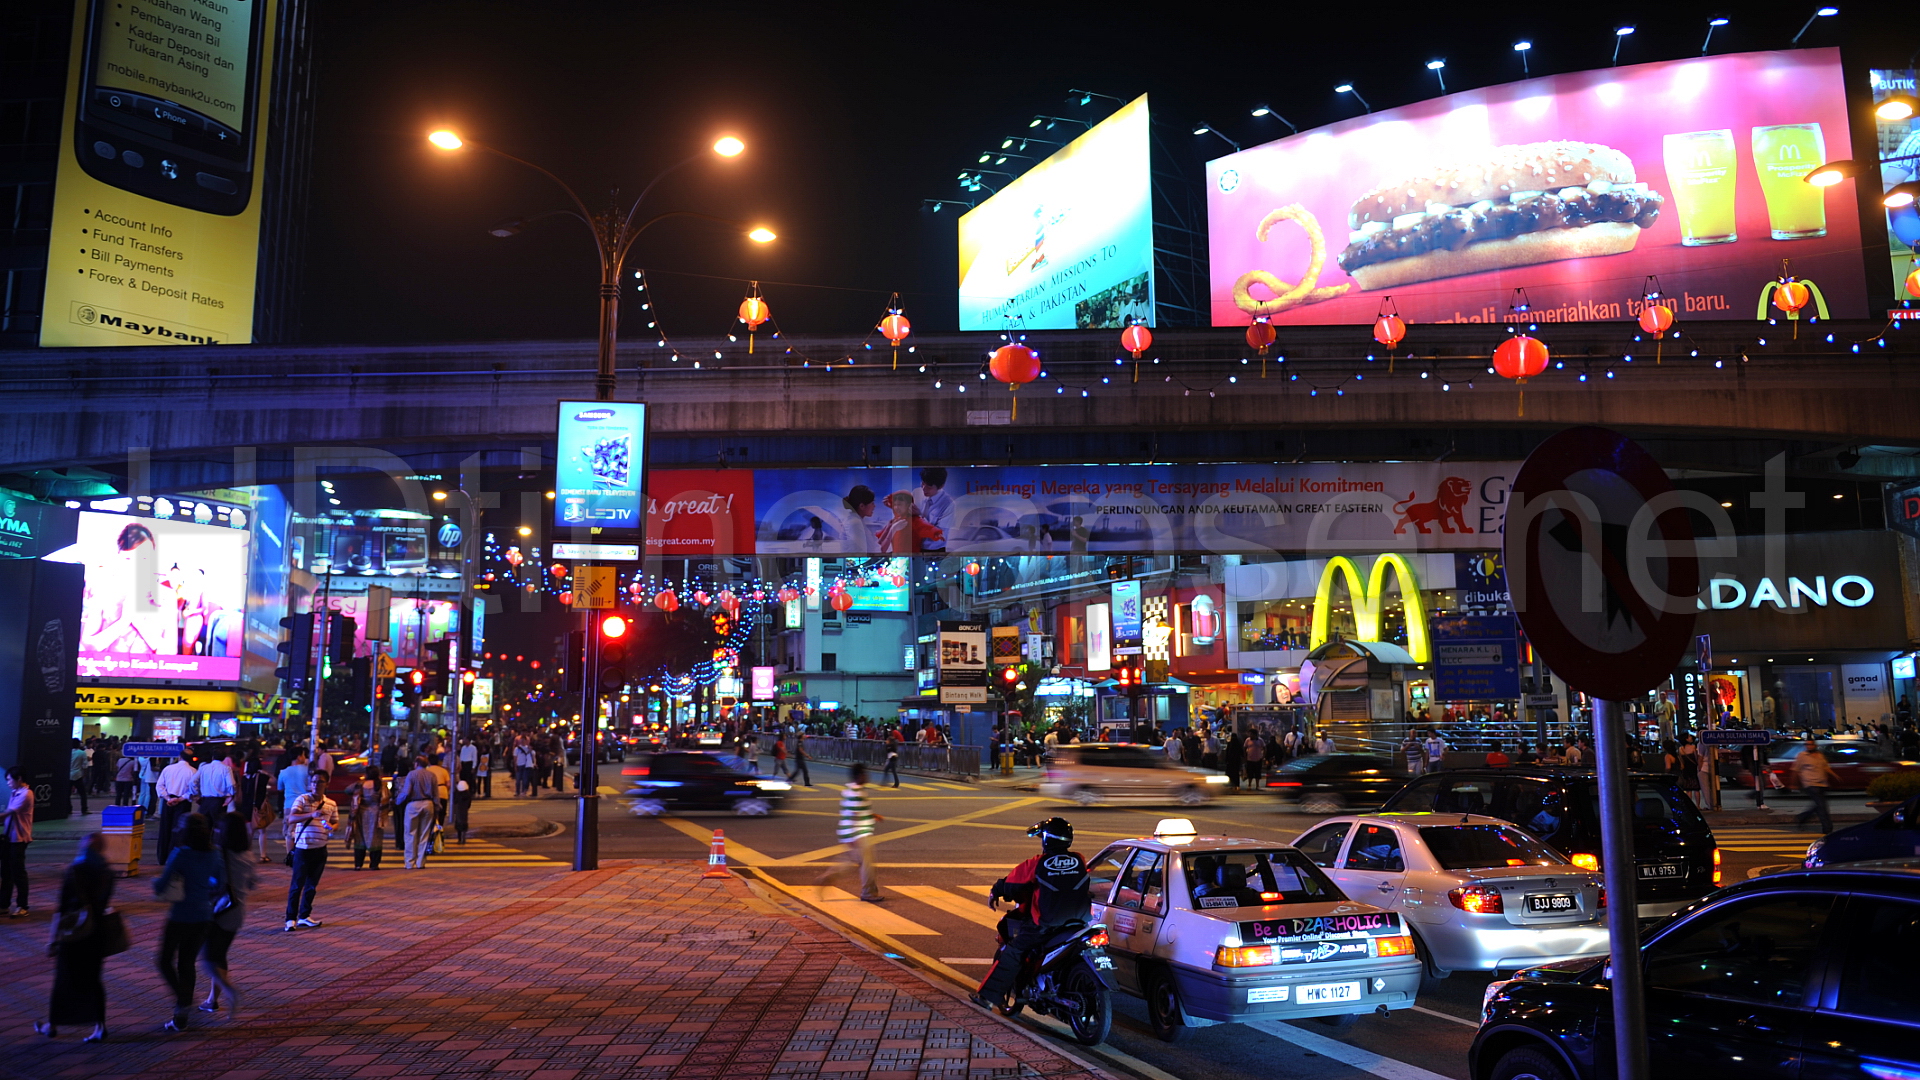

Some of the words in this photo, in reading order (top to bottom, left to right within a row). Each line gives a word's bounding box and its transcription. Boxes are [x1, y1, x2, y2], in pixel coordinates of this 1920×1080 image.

[130, 6, 202, 41] Pembayaran
[206, 34, 220, 48] Bil
[190, 9, 222, 32] Wang
[127, 38, 174, 64] Tukaran
[178, 57, 209, 78] Asing
[129, 24, 165, 45] Kadar
[168, 38, 210, 62] Deposit
[214, 56, 235, 71] dan
[107, 62, 236, 112] mobile.maybank2u.com
[1880, 80, 1916, 90] BUTIK
[162, 110, 187, 125] Phone
[94, 208, 147, 233] Account
[150, 222, 173, 239] Info
[92, 228, 125, 247] Fund
[128, 237, 184, 261] Transfers
[91, 248, 111, 263] Bill
[114, 254, 175, 278] Payments
[1051, 253, 1097, 288] MISSIONS
[1101, 244, 1117, 261] TO
[89, 268, 125, 287] Forex
[128, 278, 138, 290] &
[141, 280, 188, 302] Deposit
[191, 292, 225, 309] Rates
[1028, 308, 1036, 320] &
[1040, 280, 1088, 314] PAKISTAN
[1503, 300, 1620, 323] memeriahkan
[1684, 292, 1731, 311] baru.
[100, 313, 221, 344] Maybank
[966, 480, 1036, 499] Lindungi
[1041, 480, 1100, 495] Mereka
[1105, 482, 1144, 499] yang
[1148, 480, 1231, 499] Tersayang
[1234, 477, 1294, 494] Melalui
[1300, 476, 1384, 493] Komitmen
[662, 494, 725, 522] great
[1096, 505, 1185, 515] PERLINDUNGAN
[1187, 504, 1221, 514] ANDA
[1223, 504, 1293, 514] KEUTAMAAN
[1296, 503, 1332, 514] GREAT
[1334, 503, 1384, 514] EASTERN
[440, 527, 460, 547] hp
[646, 537, 716, 548] eisgreat.com.my
[1464, 590, 1511, 603] dibuka
[1697, 575, 1875, 610] DANO
[1848, 674, 1878, 684] ganad
[78, 693, 190, 706] Maybank
[36, 718, 60, 726] CYMA
[1046, 856, 1075, 867] Arai
[1643, 867, 1658, 877] WLK
[1658, 866, 1677, 876] 9753
[1534, 898, 1550, 910] BJJ
[1552, 898, 1571, 909] 9809
[1253, 923, 1273, 937] Be
[1278, 924, 1287, 935] a
[1292, 915, 1382, 934] DZARHOLIC
[1262, 937, 1278, 945] Your
[1278, 935, 1302, 943] Premier
[1325, 931, 1351, 939] Discount
[1307, 988, 1328, 1000] HWC
[1330, 986, 1351, 999] 1127
